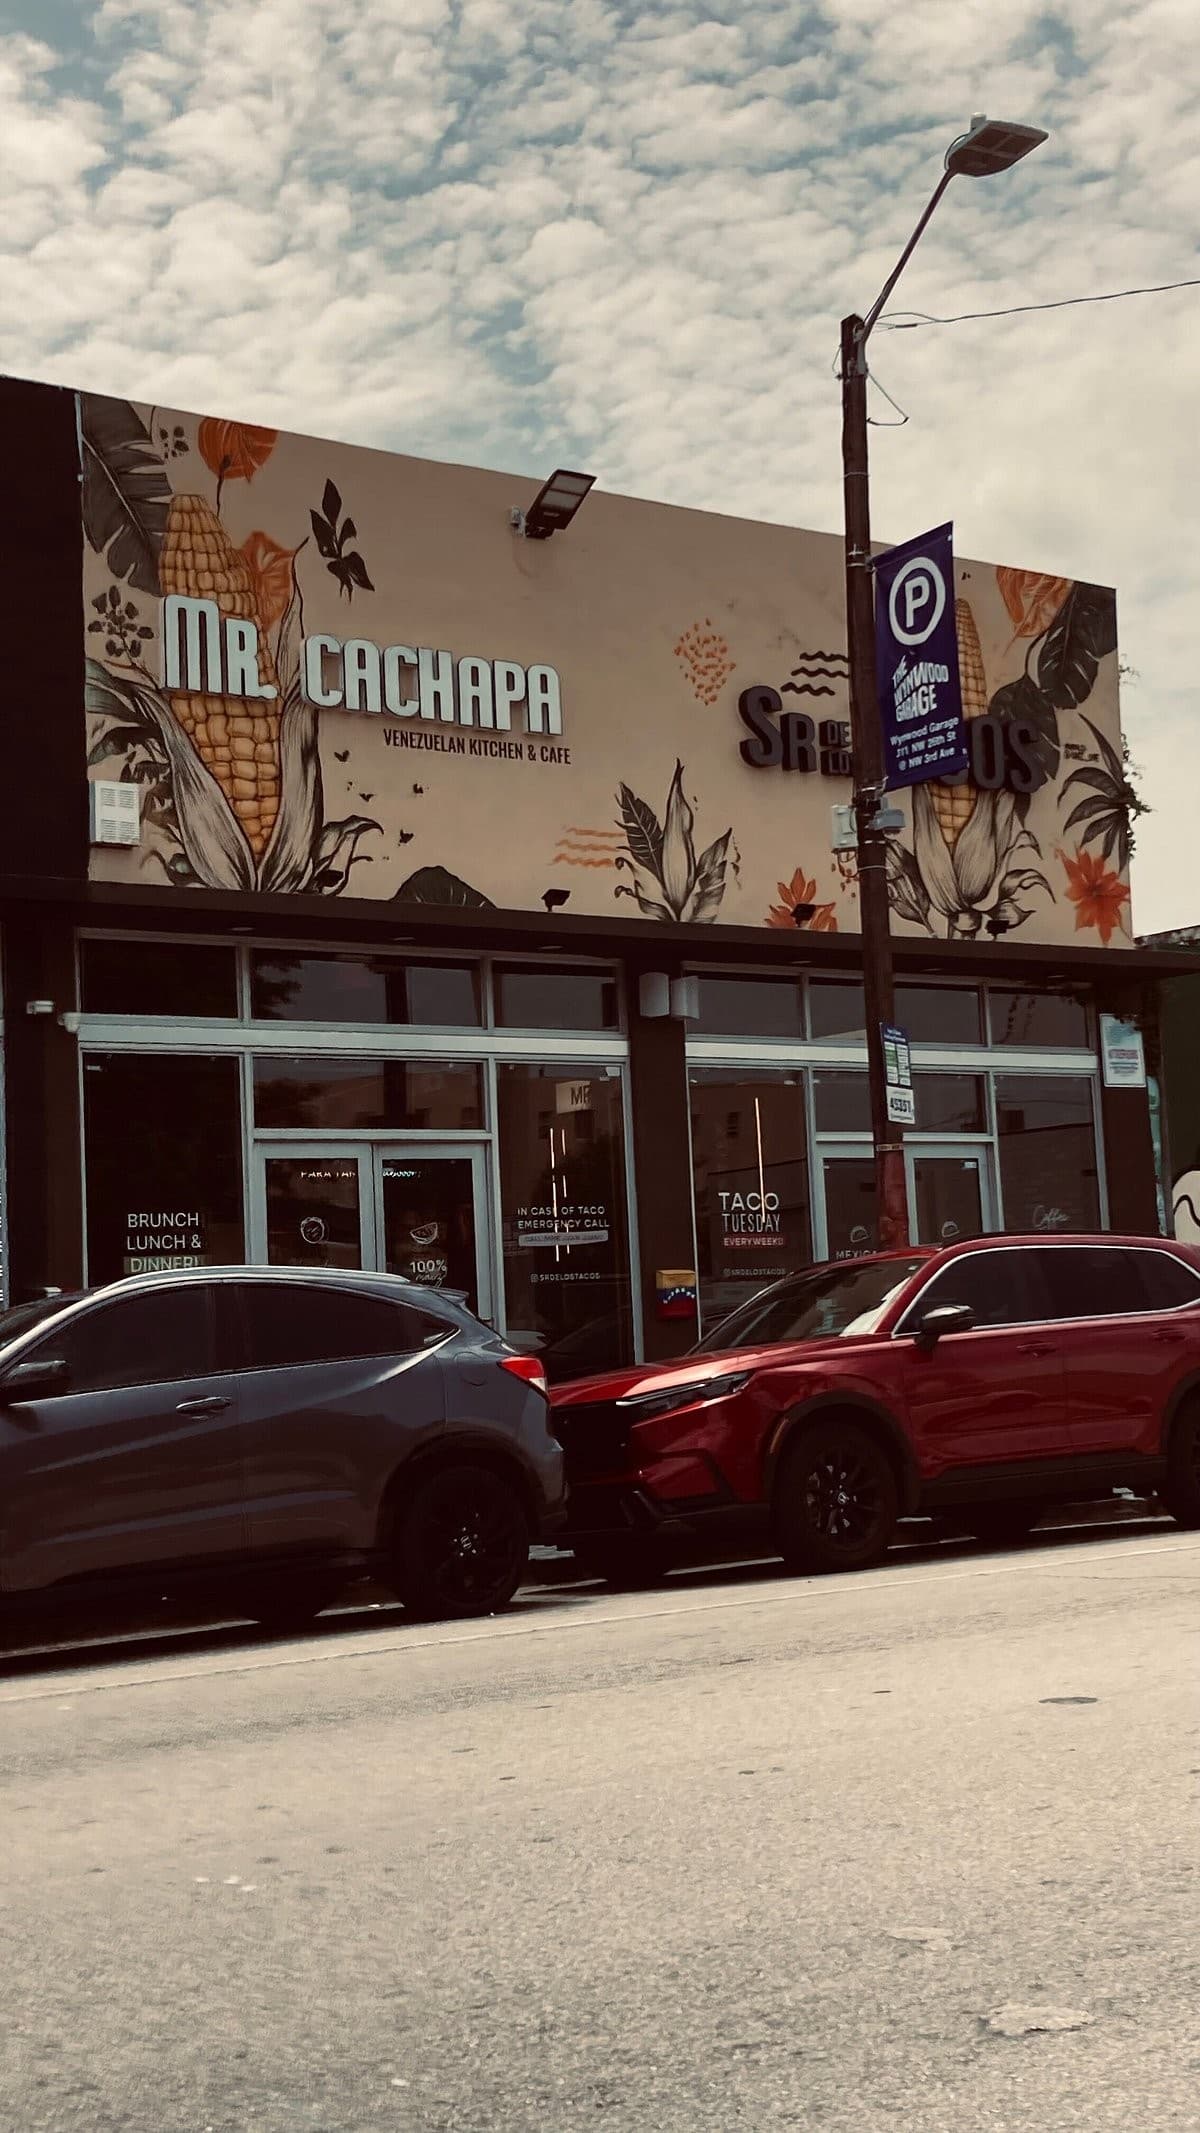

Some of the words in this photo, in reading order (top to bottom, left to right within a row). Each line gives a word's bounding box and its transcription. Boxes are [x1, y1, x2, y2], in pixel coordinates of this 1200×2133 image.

[163, 594, 278, 699] MR.
[304, 633, 562, 736] CACHAPA
[894, 662, 949, 706] WYNWOOD
[896, 684, 938, 722] GARAGE
[890, 725, 928, 746] Wynwood
[929, 717, 960, 733] Garage
[911, 740, 926, 753] NW
[946, 731, 957, 742] St
[383, 728, 466, 755] VENEZUELAN
[469, 737, 524, 761] KITCHEN
[527, 743, 537, 762] &
[540, 745, 571, 765] CAFE
[908, 755, 922, 768] NW
[923, 750, 938, 763] 3rd
[939, 746, 955, 759] Ave
[820, 749, 856, 777] LO
[517, 1207, 528, 1215] IN
[531, 1206, 557, 1216] CAS
[561, 1206, 575, 1215] OF
[577, 1206, 606, 1215] TACO
[718, 1192, 780, 1211] TACO
[127, 1212, 199, 1228] BRUNCH
[517, 1219, 581, 1229] EMERGENCY
[584, 1219, 610, 1228] CALL
[721, 1213, 780, 1232] TUESDAY
[126, 1234, 186, 1251] LUNCH
[191, 1233, 202, 1249] &
[409, 1259, 448, 1273] 100%
